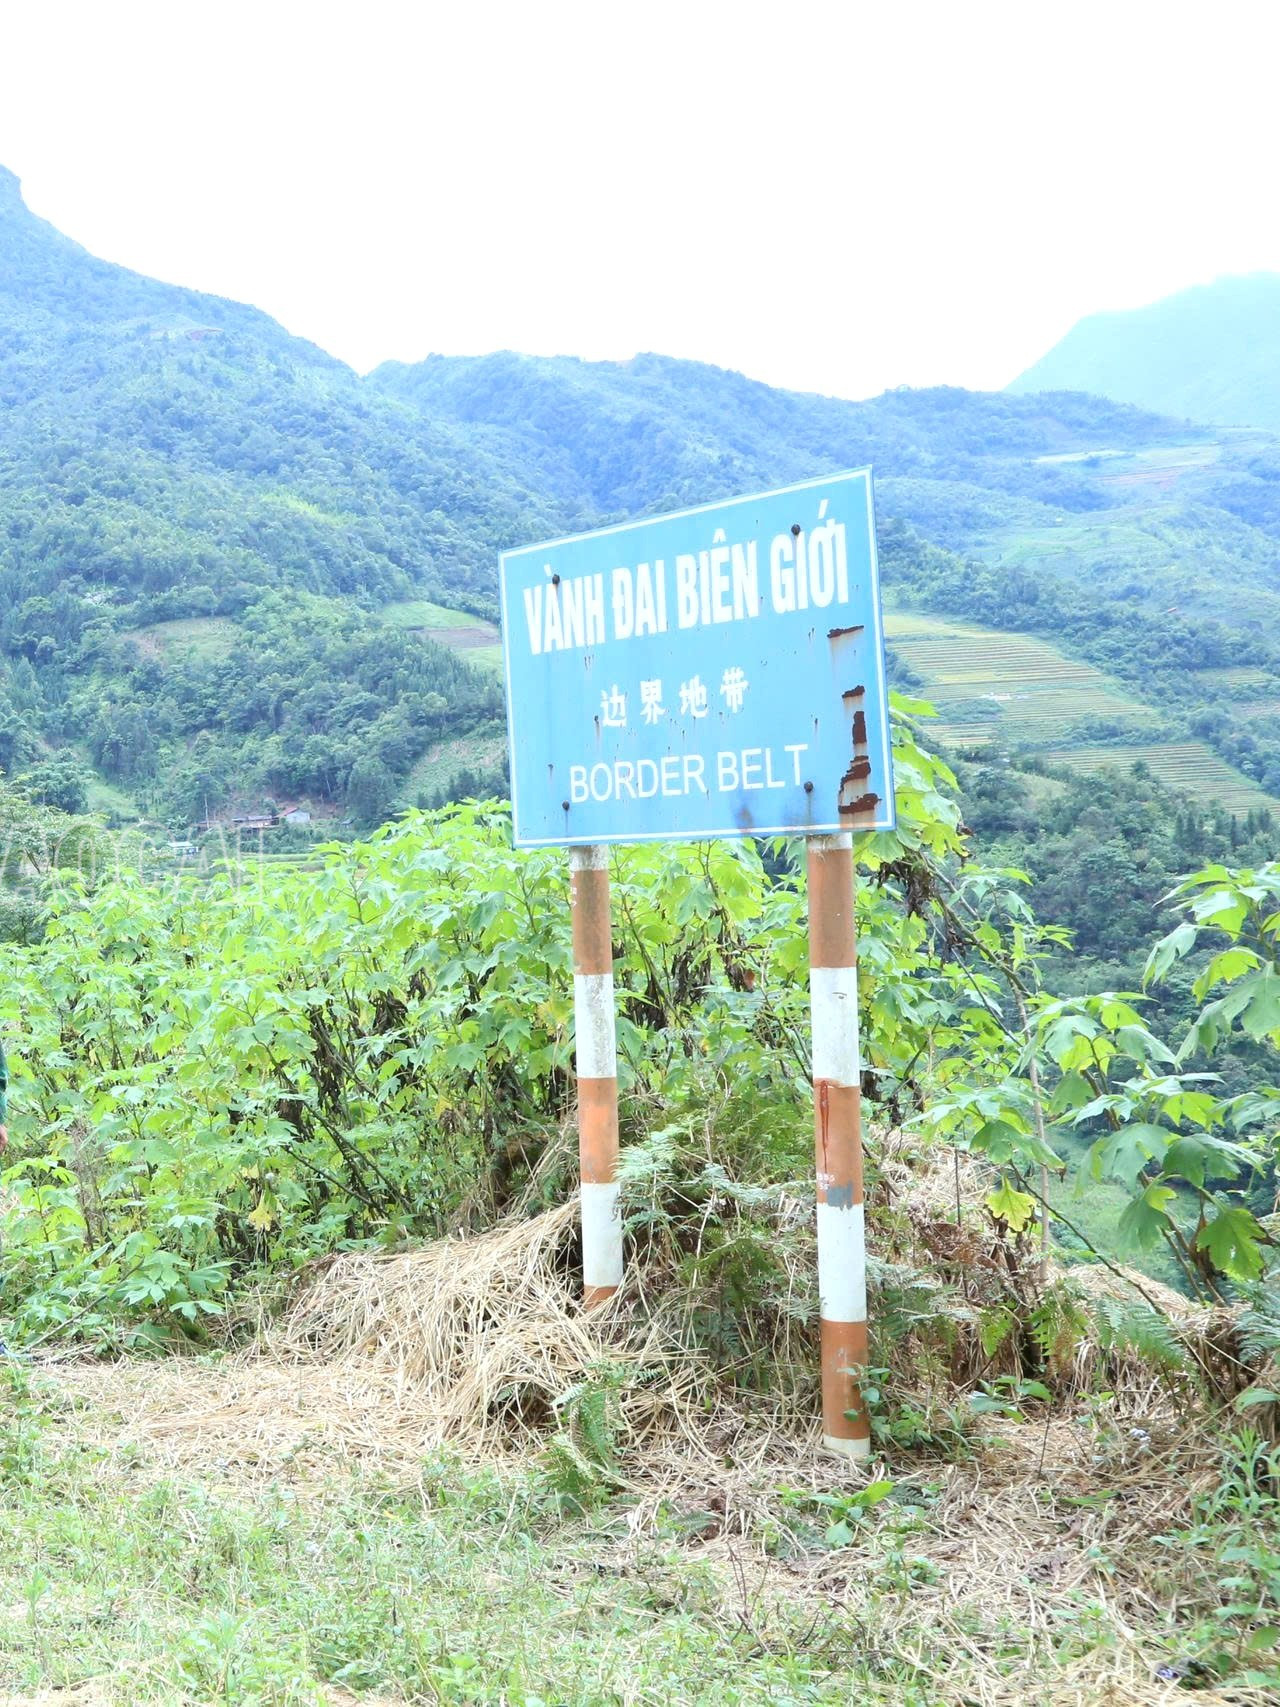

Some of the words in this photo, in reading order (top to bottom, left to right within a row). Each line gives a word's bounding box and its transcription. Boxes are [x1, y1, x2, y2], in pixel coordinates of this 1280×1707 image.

[523, 564, 605, 655] VÀNH
[612, 559, 668, 640] ĐAI
[675, 527, 759, 630] BIÊN
[769, 499, 849, 614] GIỚI
[599, 666, 749, 728] 边界地带
[569, 754, 707, 803] BORDER
[717, 744, 809, 792] BELT
